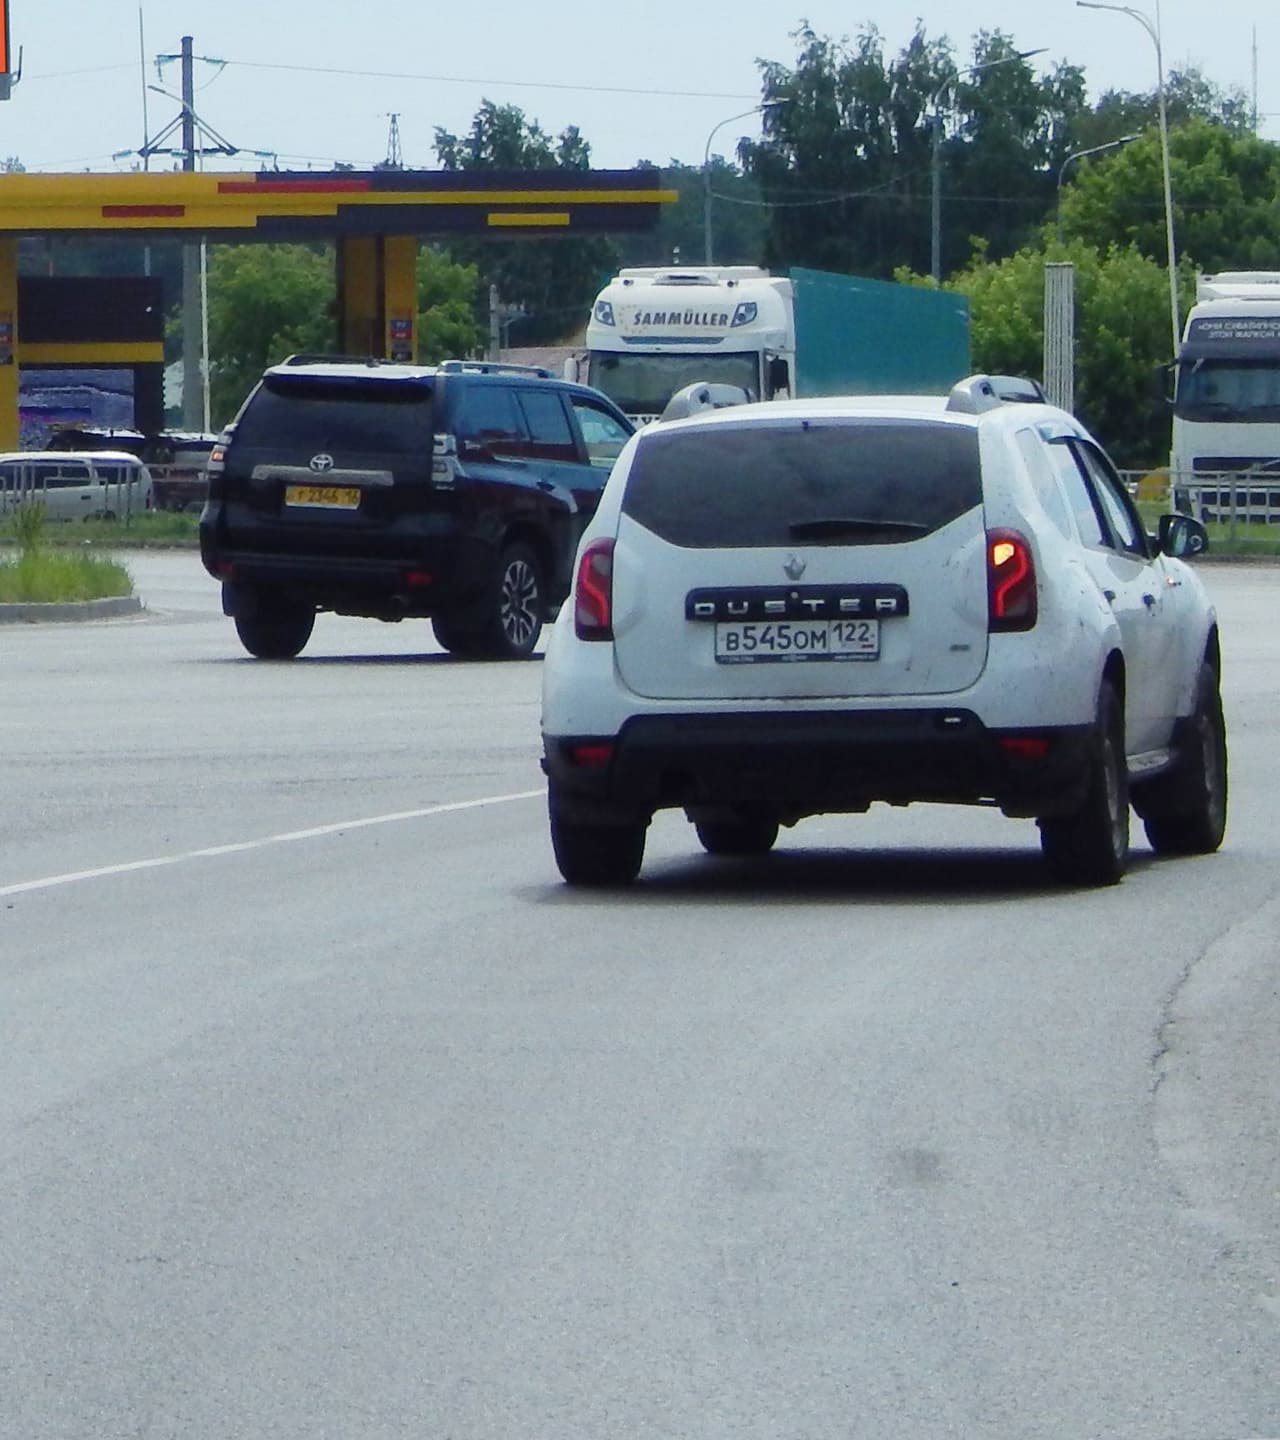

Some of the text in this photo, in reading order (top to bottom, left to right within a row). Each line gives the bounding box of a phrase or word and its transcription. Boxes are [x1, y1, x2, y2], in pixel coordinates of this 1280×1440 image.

[633, 308, 729, 326] SAMMÜLLER
[694, 598, 897, 615] DUSTER
[833, 622, 870, 642] 122
